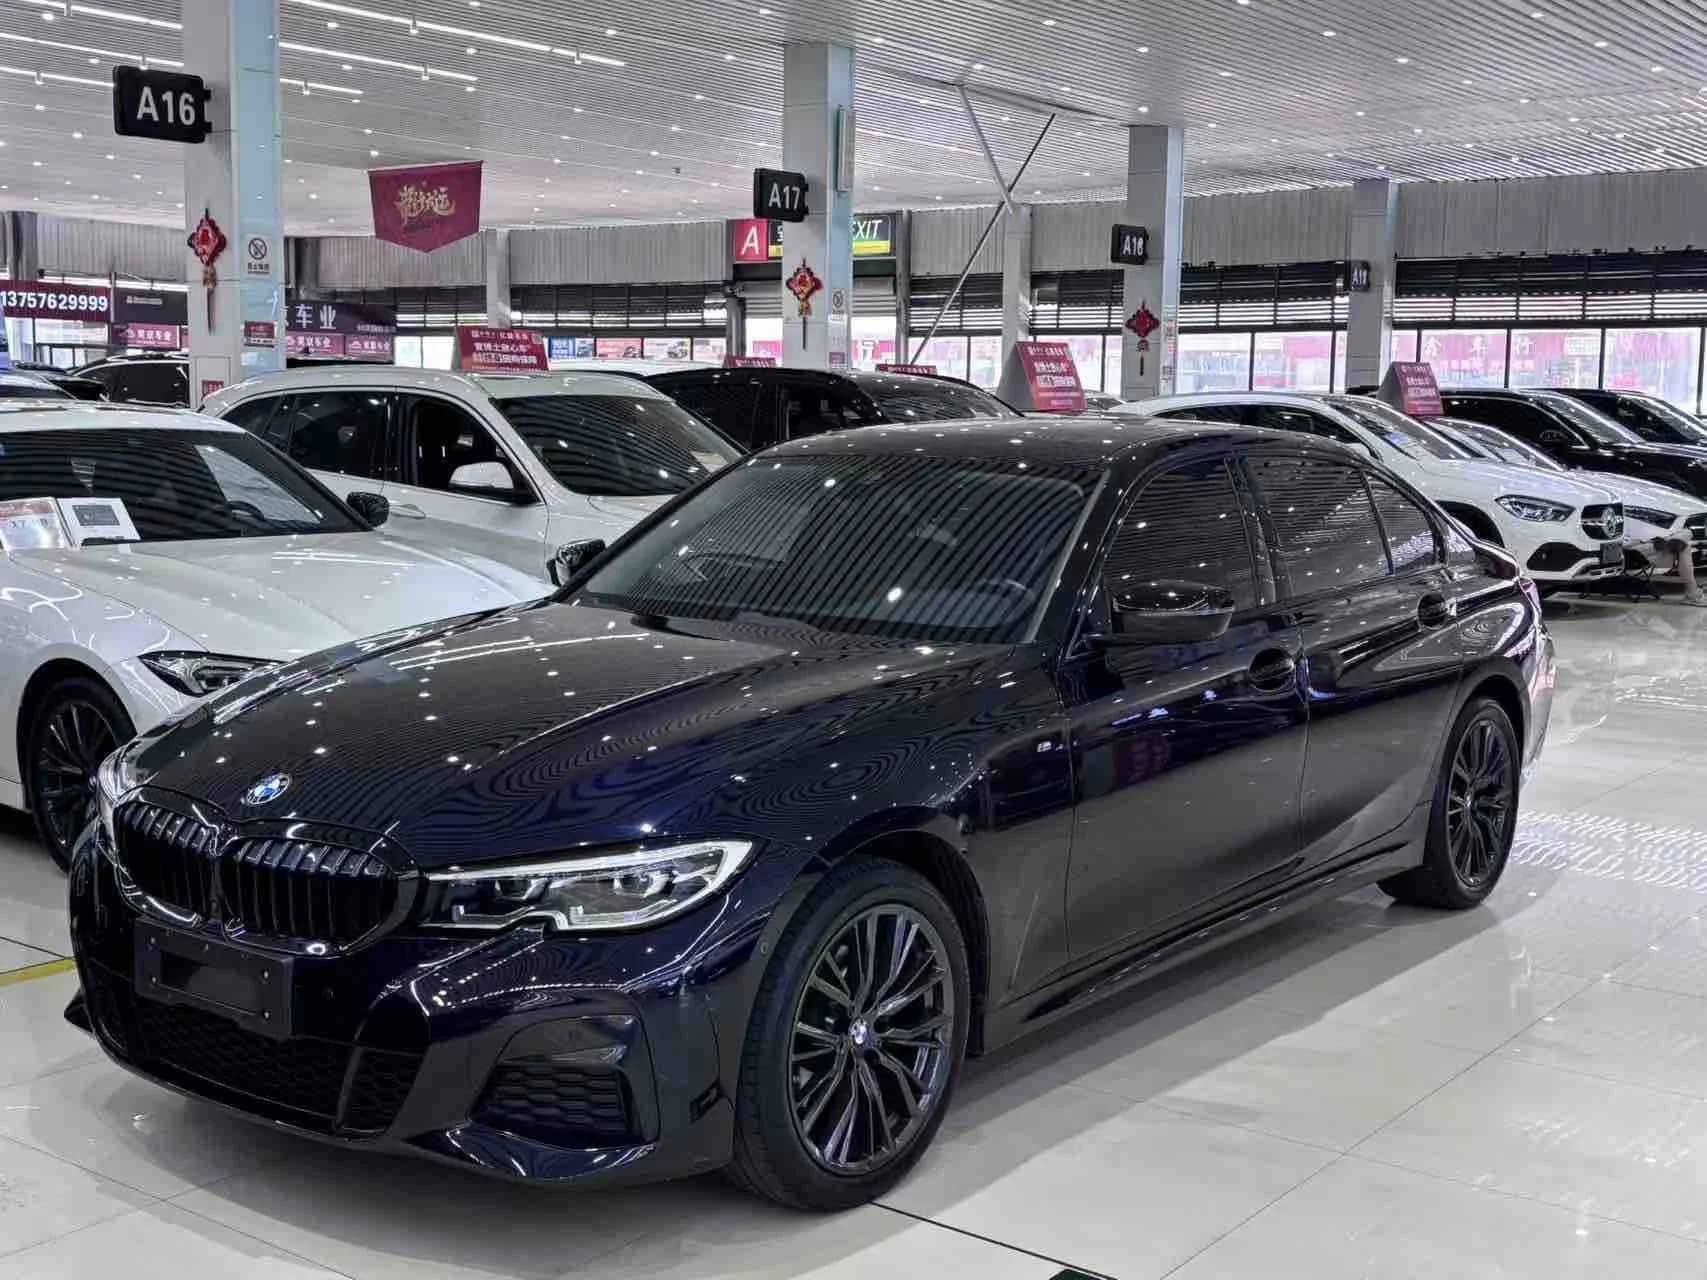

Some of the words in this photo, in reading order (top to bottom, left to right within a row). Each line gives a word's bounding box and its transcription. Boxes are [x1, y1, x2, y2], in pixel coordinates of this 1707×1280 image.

[136, 85, 196, 126] A16
[768, 182, 800, 211] A17
[740, 226, 760, 255] A
[0, 290, 108, 312] 13757629999
[284, 303, 337, 330] 车业
